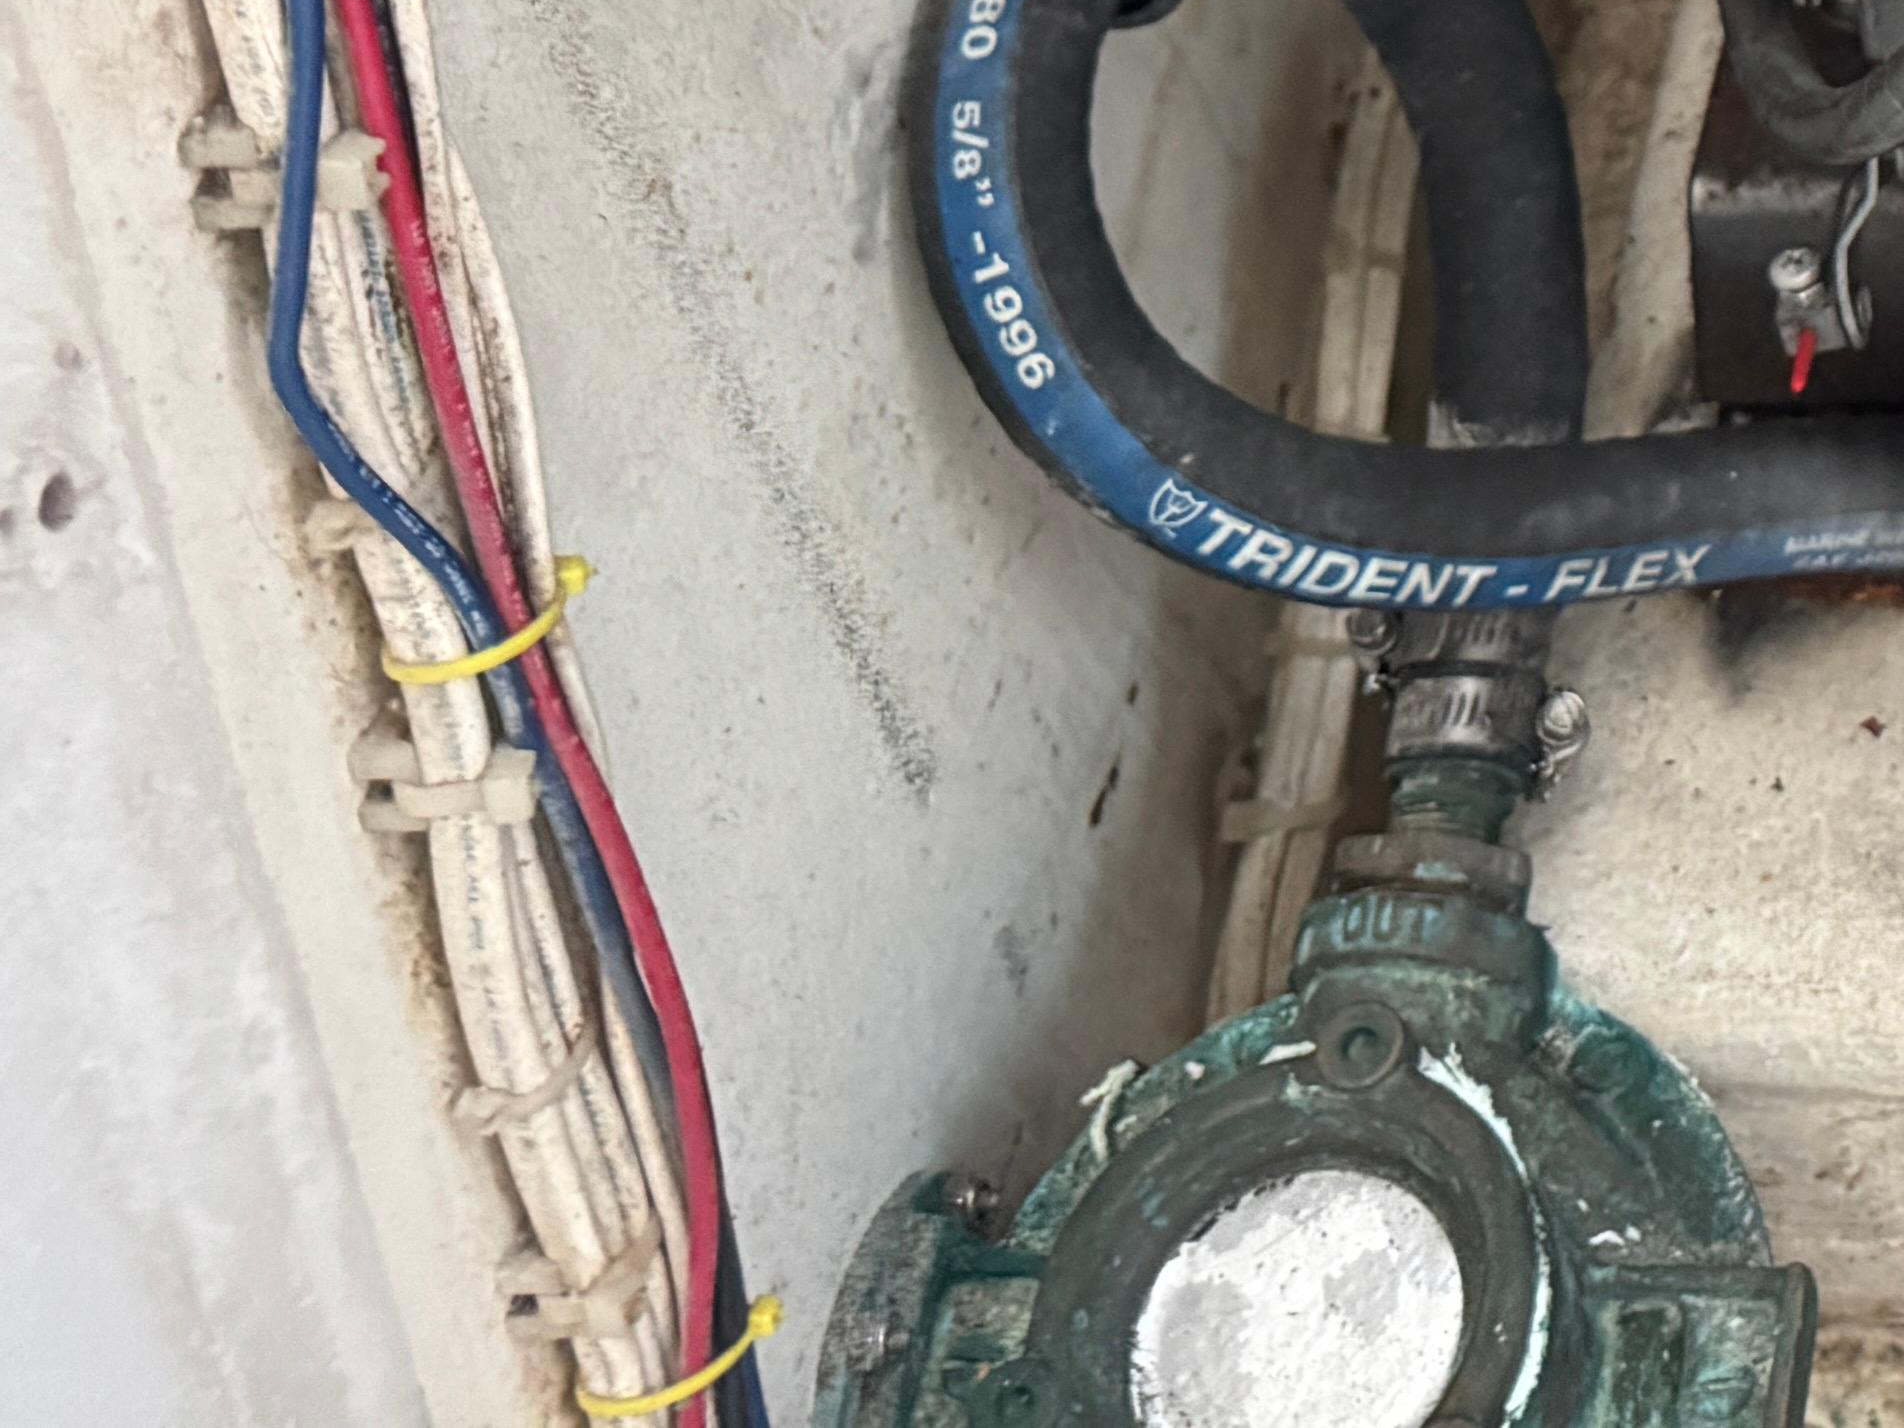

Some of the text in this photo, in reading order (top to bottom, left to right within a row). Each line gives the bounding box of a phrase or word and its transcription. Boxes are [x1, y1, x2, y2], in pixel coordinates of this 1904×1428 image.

[1197, 506, 1499, 608] TRIDENT
[1542, 543, 1711, 601] FLEX
[1340, 896, 1445, 945] OUT
